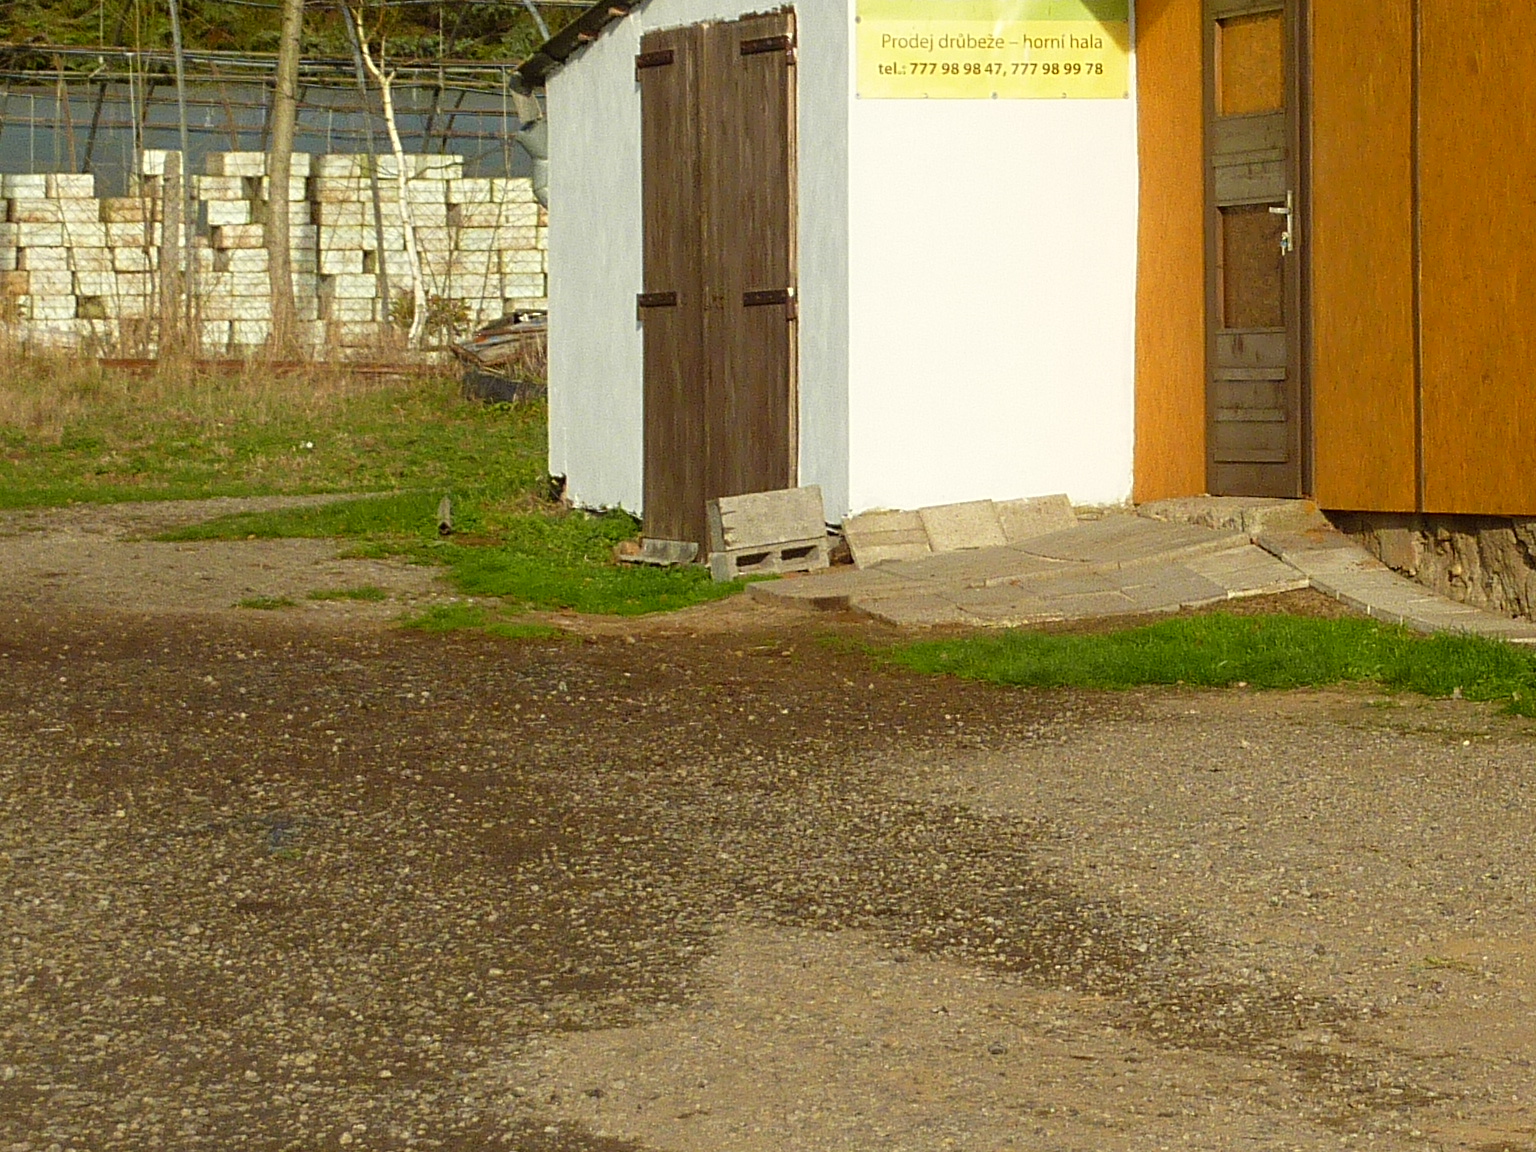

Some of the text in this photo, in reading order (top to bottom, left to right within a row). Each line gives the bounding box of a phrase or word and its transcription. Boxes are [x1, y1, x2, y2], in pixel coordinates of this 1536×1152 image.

[882, 33, 933, 52] Prodej
[938, 33, 1005, 49] drůbeže
[1024, 34, 1065, 49] horní
[1070, 34, 1103, 49] hala
[910, 63, 936, 75] 777
[941, 63, 960, 75] 98
[964, 63, 981, 75] 98
[985, 63, 1007, 77] 47,
[1011, 63, 1037, 75] 777
[1042, 63, 1060, 75] 98
[1063, 63, 1081, 75] 99
[1086, 63, 1103, 75] 78
